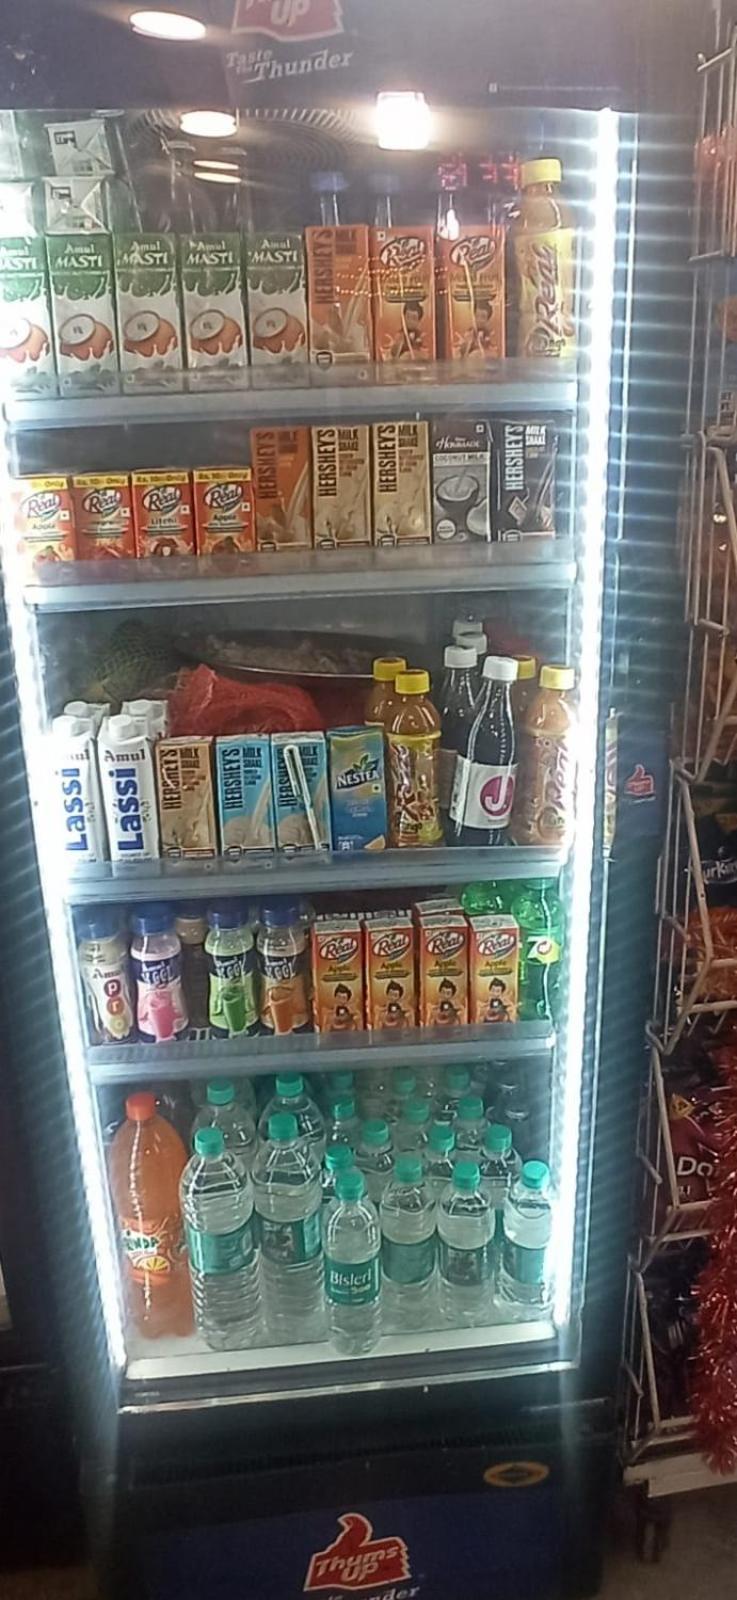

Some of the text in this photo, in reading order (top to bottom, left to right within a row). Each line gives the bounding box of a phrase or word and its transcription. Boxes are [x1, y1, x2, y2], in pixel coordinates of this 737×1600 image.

[244, 49, 353, 84] Thunder
[64, 243, 95, 254] Amul
[131, 241, 161, 251] Amul
[196, 240, 226, 251] Amul
[261, 239, 291, 249] Amul
[0, 257, 37, 270] ASTI
[55, 255, 103, 268] MASTI
[120, 252, 168, 266] MASTI
[187, 252, 234, 265] MASTI
[252, 250, 298, 263] MASTI
[148, 487, 178, 512] Real
[209, 485, 239, 509] Real
[103, 749, 147, 762] Amul
[337, 770, 380, 788] NESTEA
[55, 767, 89, 851] Lassi
[108, 767, 145, 851] Lassi
[325, 938, 354, 960] Real
[377, 935, 407, 956] Real
[432, 934, 462, 955] Real
[483, 935, 512, 955] Real
[329, 1267, 372, 1286] Bisleri
[315, 1546, 399, 1578] Thums
[341, 1562, 379, 1583] UP
